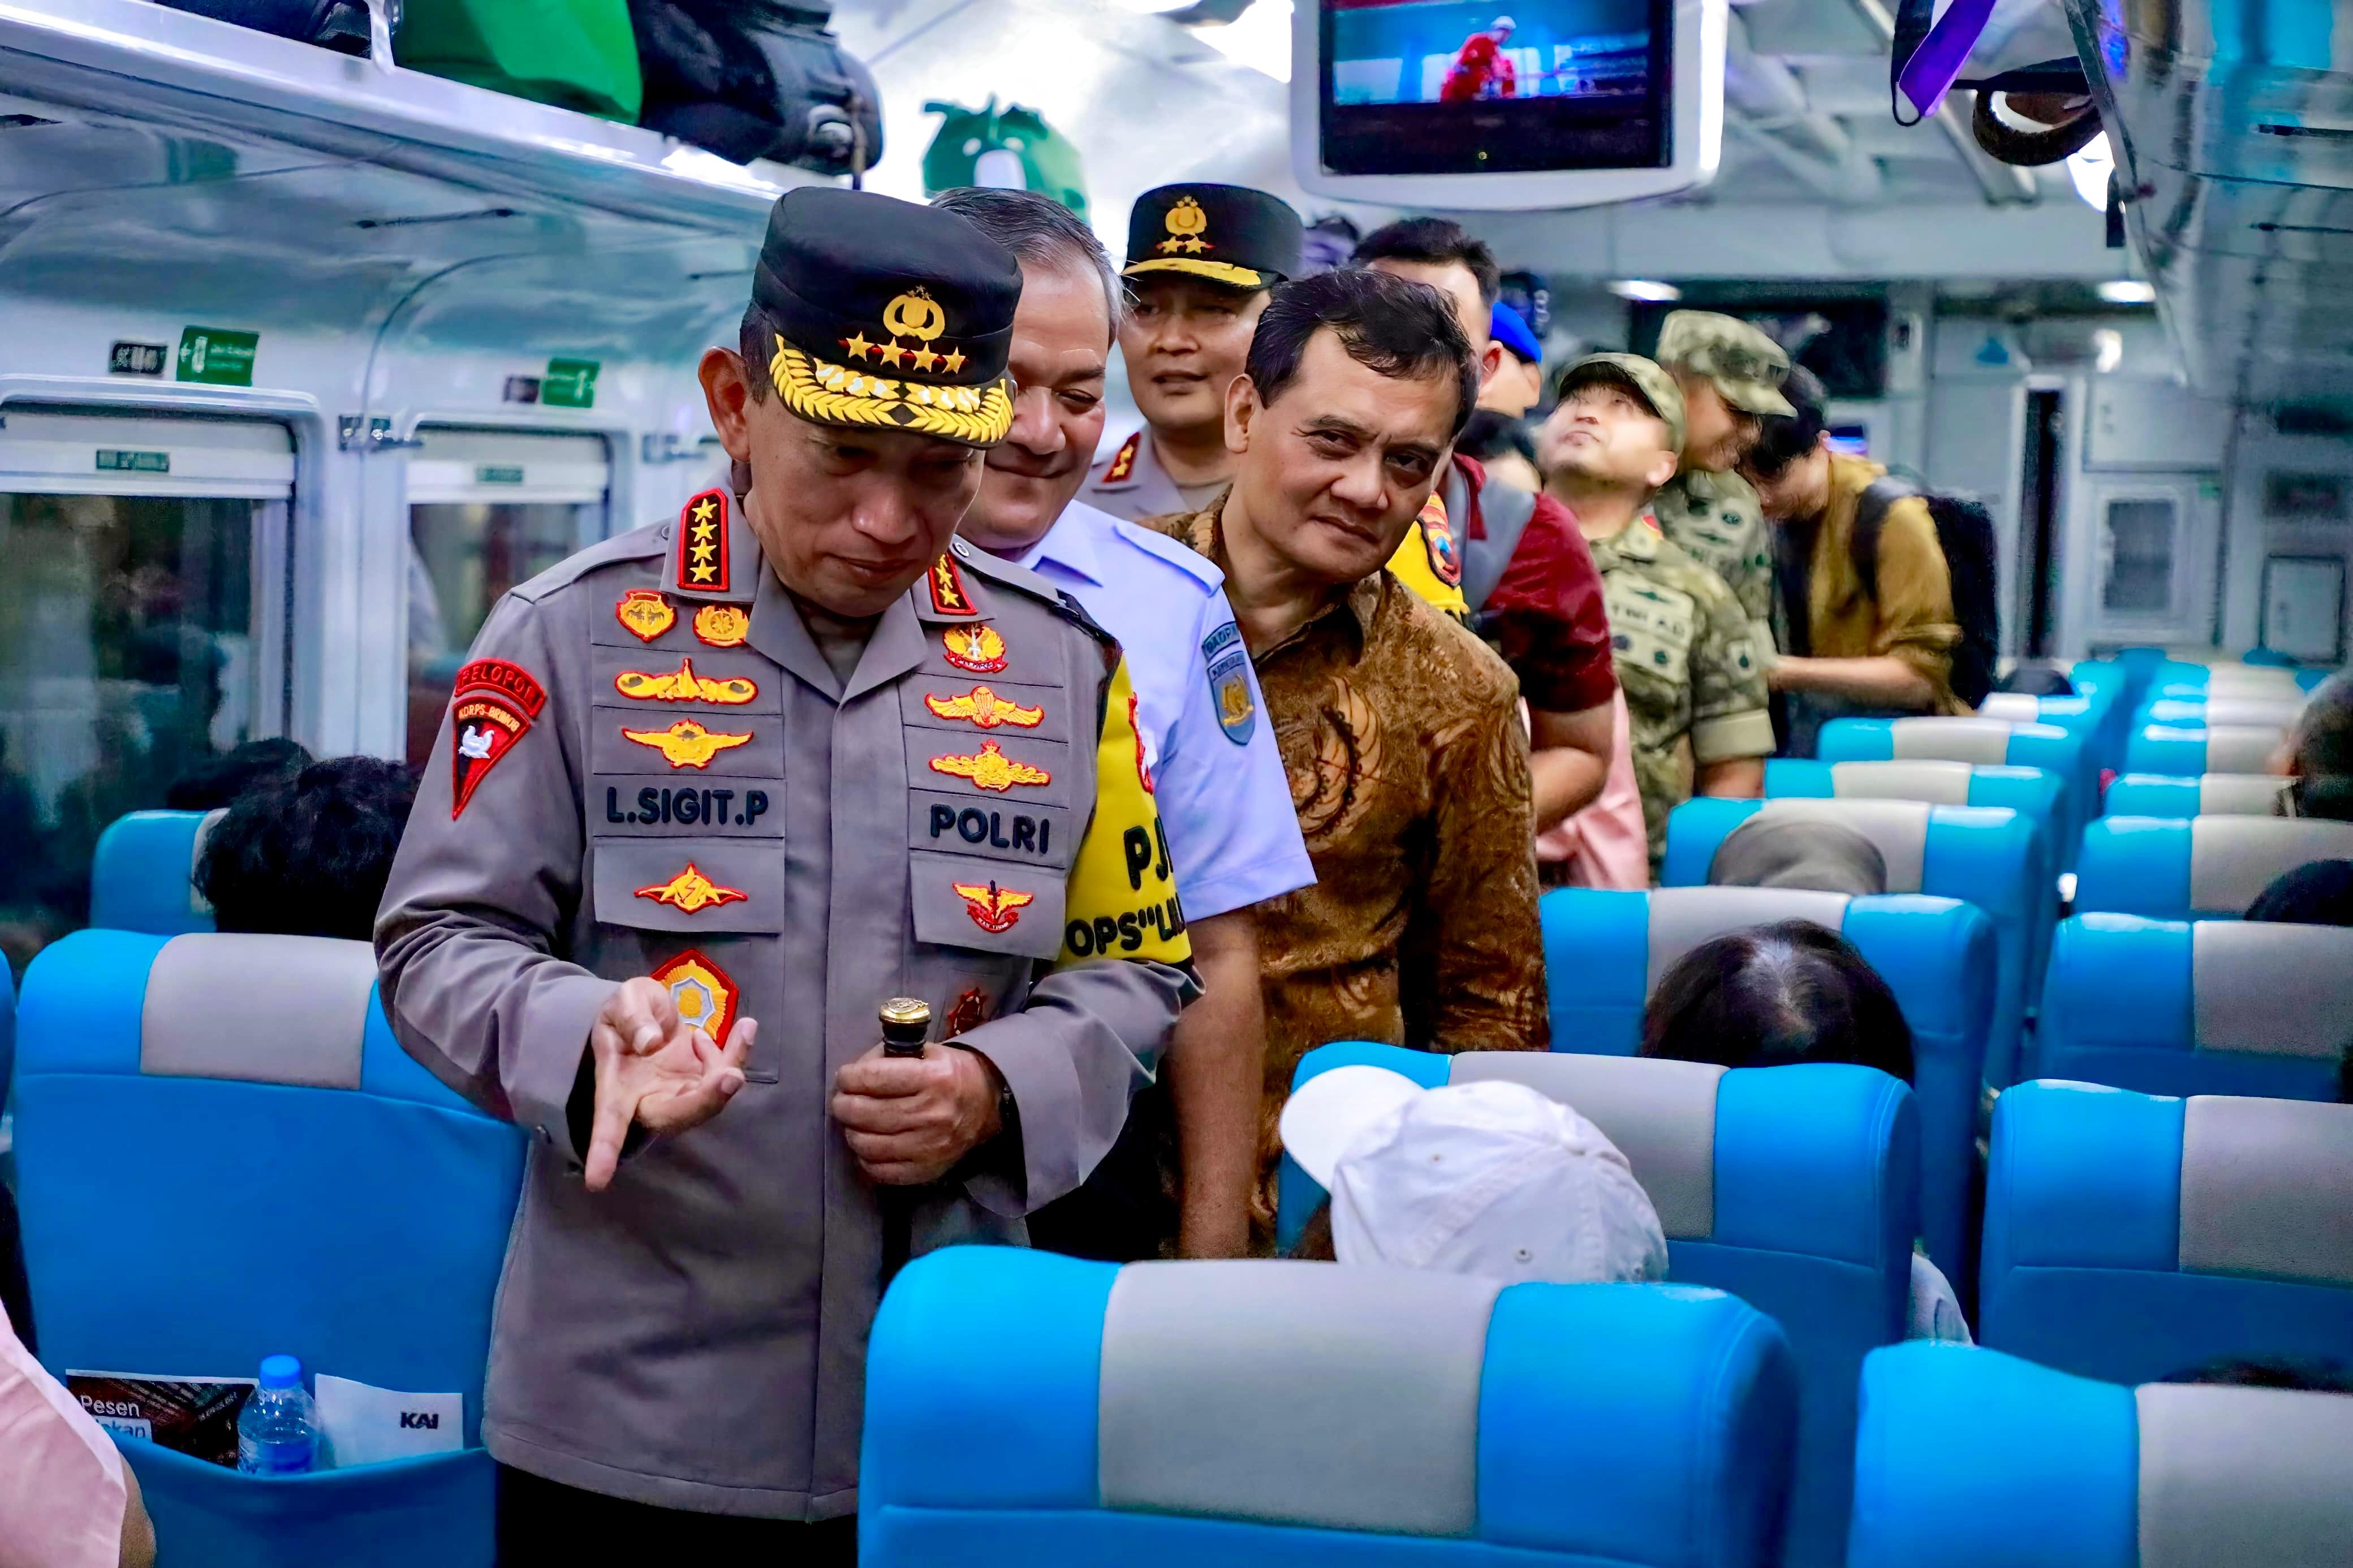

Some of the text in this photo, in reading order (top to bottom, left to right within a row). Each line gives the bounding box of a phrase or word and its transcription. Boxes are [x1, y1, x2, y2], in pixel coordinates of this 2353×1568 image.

[606, 786, 769, 826] L.SIGIT.P
[930, 804, 1050, 854] POLRI
[1123, 814, 1174, 891] PJ
[80, 1394, 140, 1417] Pesen
[400, 1412, 439, 1429] KAI
[96, 1419, 146, 1439] kan
